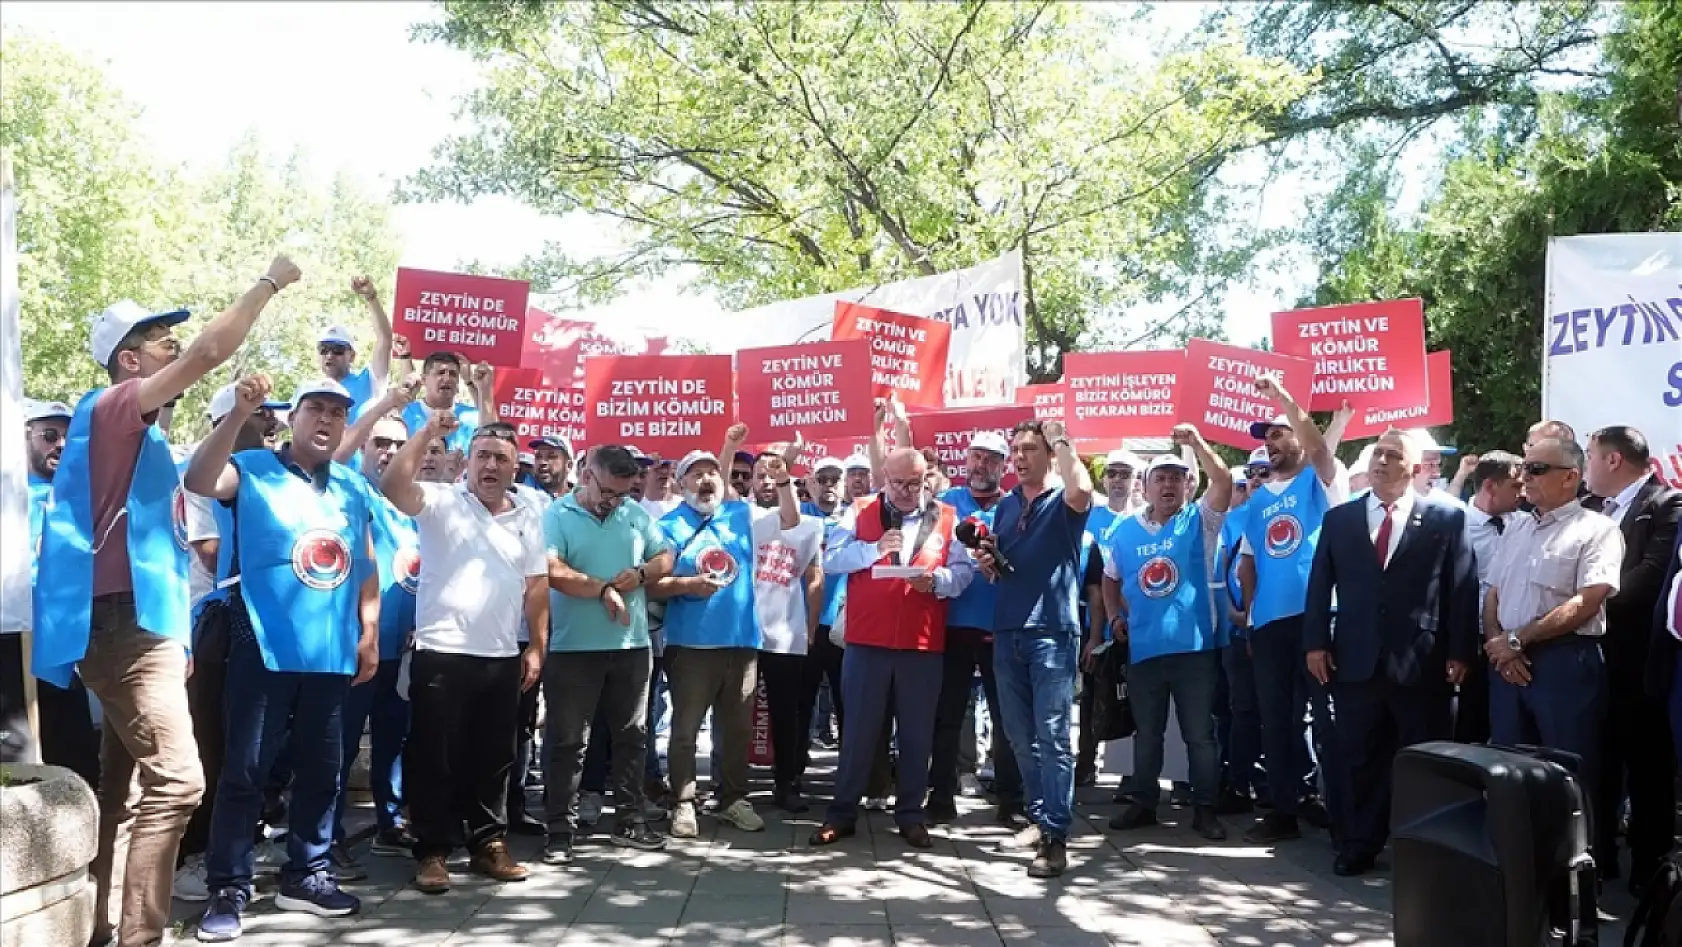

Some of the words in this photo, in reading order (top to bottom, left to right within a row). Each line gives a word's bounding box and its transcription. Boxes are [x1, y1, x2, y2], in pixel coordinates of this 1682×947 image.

[420, 291, 479, 309] ZEYTİN
[483, 298, 505, 313] DE
[973, 291, 1022, 327] YOK
[404, 306, 453, 326] BİZİM
[455, 311, 519, 331] KÖMÜR
[1298, 317, 1360, 338] ZEYTİN
[1364, 317, 1389, 332] VE
[1549, 294, 1681, 356] ZEYTİN
[425, 327, 446, 341] DE
[448, 328, 497, 346] BİZİM
[856, 316, 906, 338] ZEYTİN
[908, 328, 927, 342] VE
[869, 336, 915, 356] ÖMÜR
[1311, 335, 1379, 356] KÖMÜR
[762, 354, 819, 373] ZEYTİN
[821, 355, 843, 368] VE
[1208, 355, 1261, 377] ZEYTİN
[611, 375, 678, 395] ZEYTİN
[682, 379, 706, 394] DE
[772, 370, 834, 390] KÖMÜR
[1070, 374, 1120, 388] ZEYTİNİ
[1311, 374, 1394, 394] MÜMKÜN
[514, 386, 570, 404] ZEYTİN
[771, 391, 840, 408] BİRLİKTE
[1075, 388, 1108, 402] BİZİZ
[499, 403, 544, 420] BİZİM
[597, 397, 649, 416] BİZİM
[653, 395, 725, 416] KÖMÜR
[1075, 405, 1137, 420] ÇIKARAN
[1140, 402, 1174, 416] BİZİZ
[1209, 392, 1275, 420] BİRLİKTE
[620, 421, 645, 437] DE
[649, 417, 701, 436] BİZİM
[770, 407, 847, 427] MÜMKÜN
[518, 423, 539, 437] DE
[542, 422, 586, 441] BİZİM
